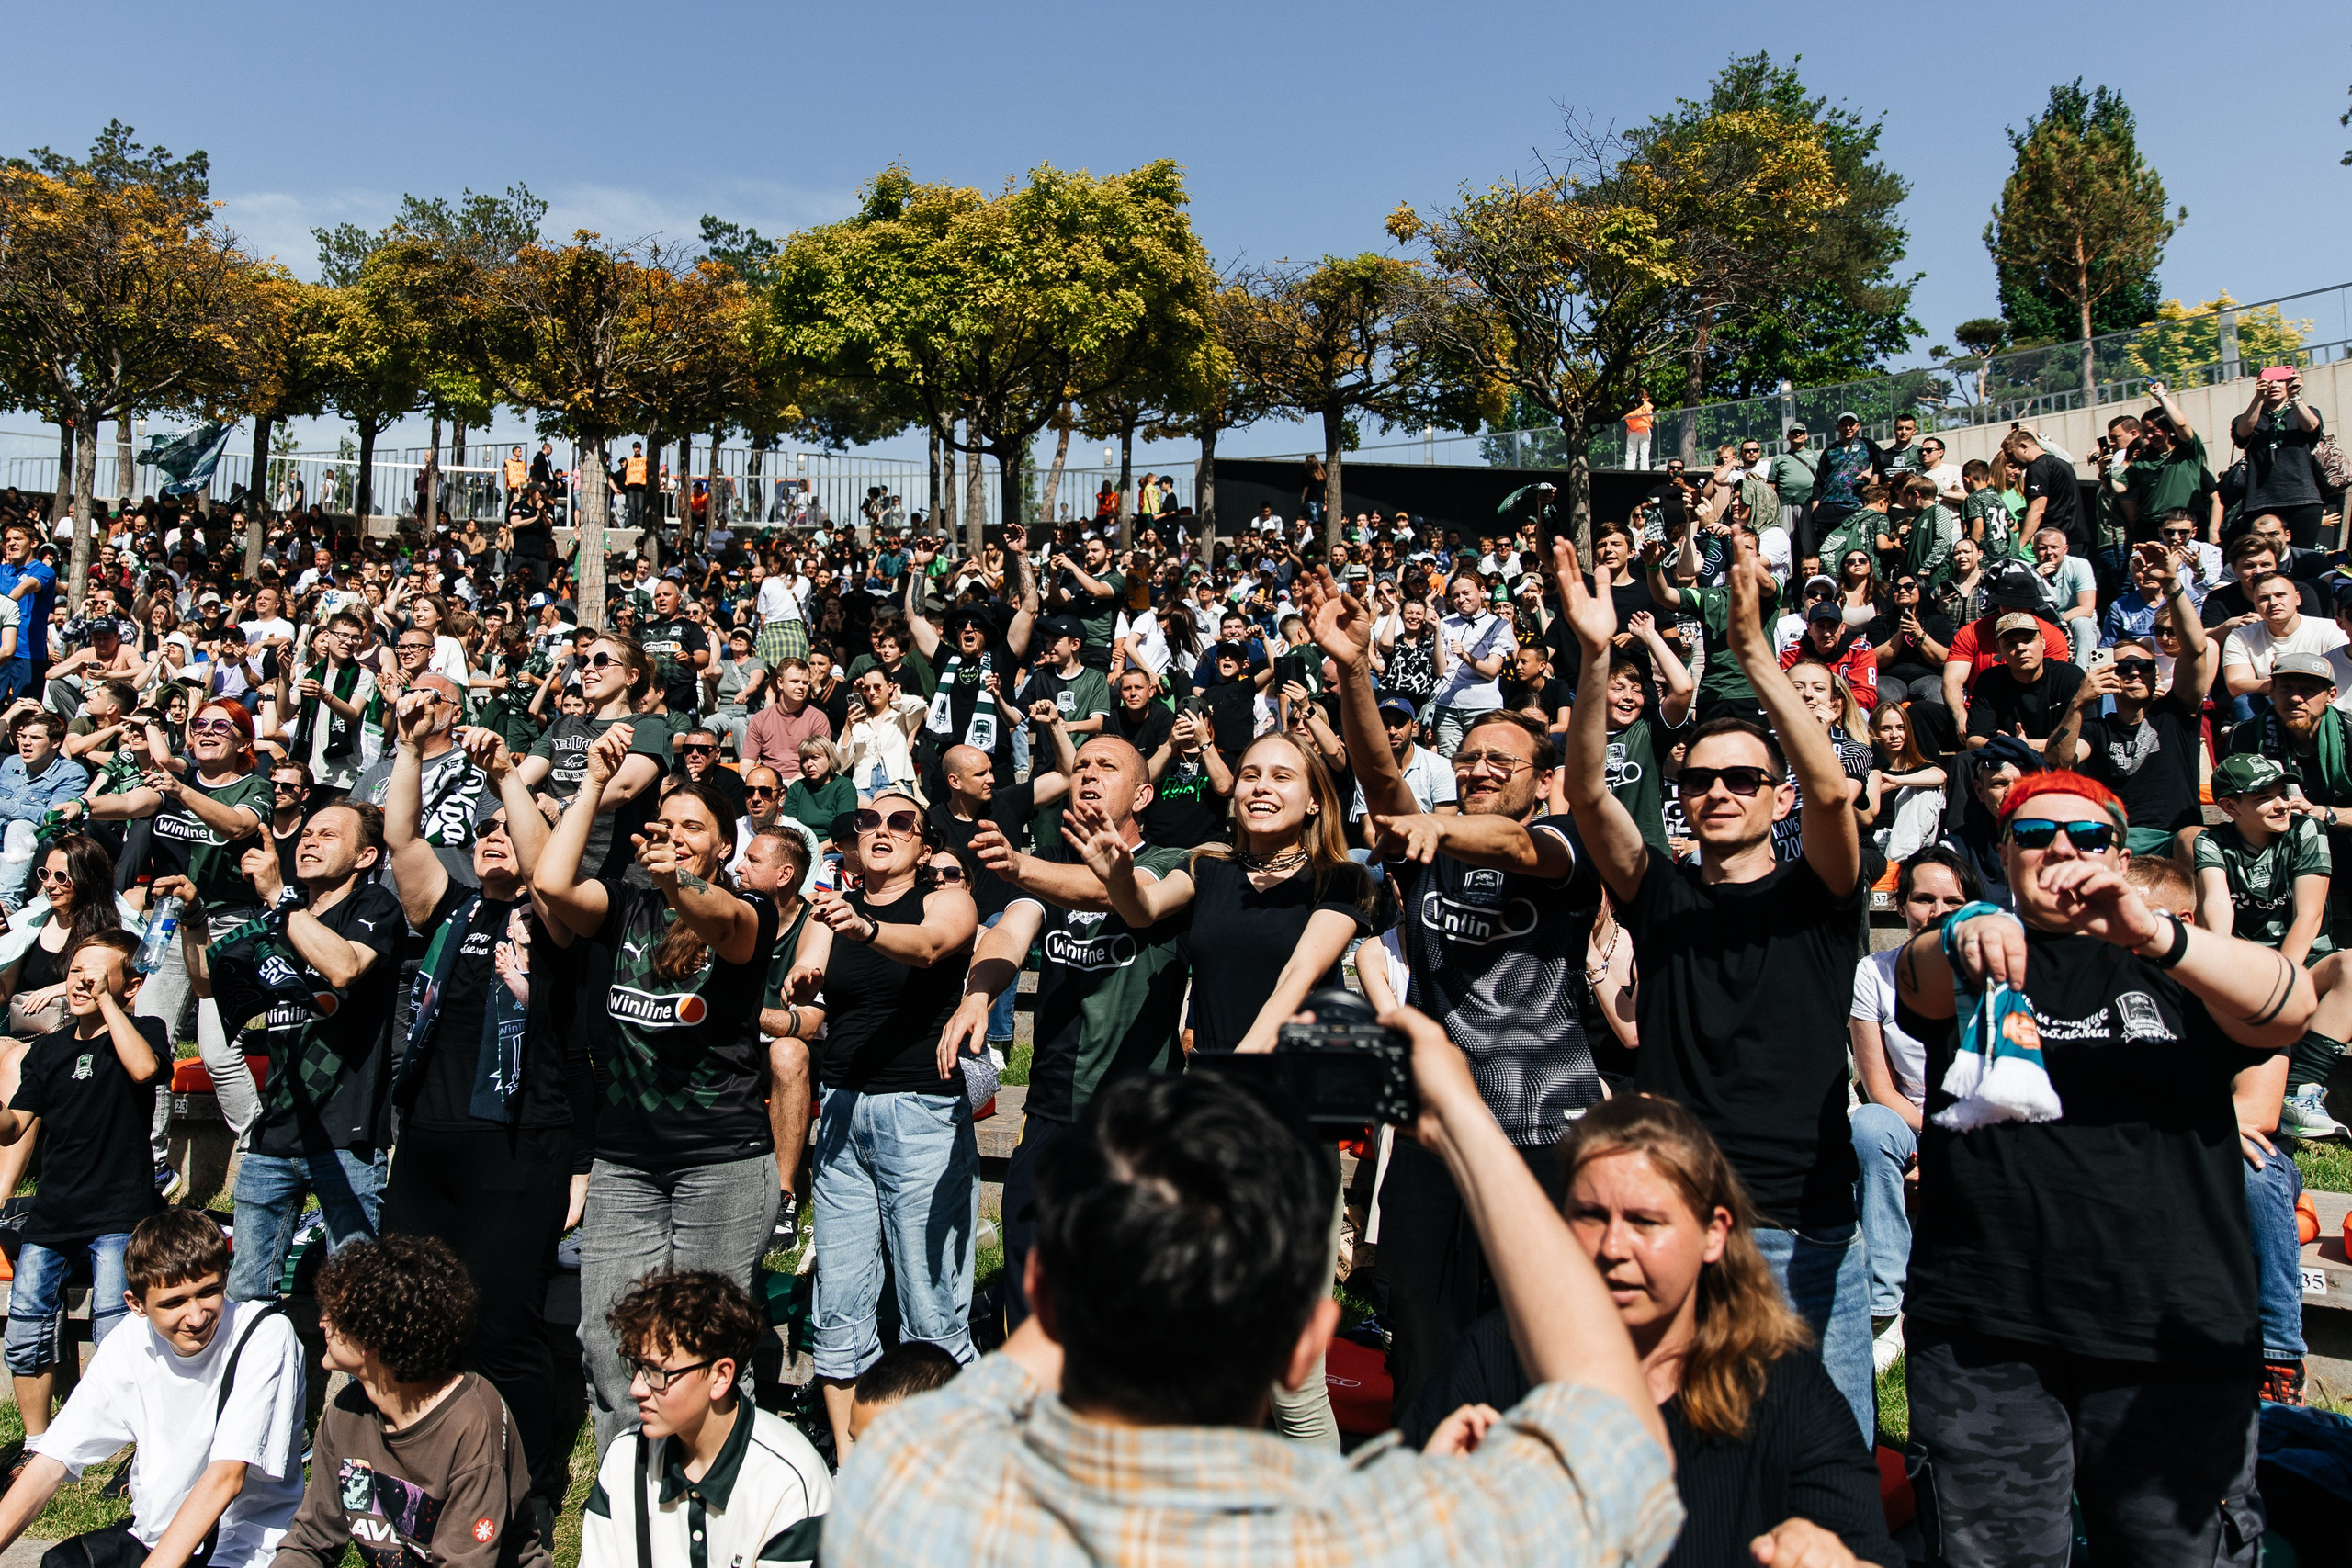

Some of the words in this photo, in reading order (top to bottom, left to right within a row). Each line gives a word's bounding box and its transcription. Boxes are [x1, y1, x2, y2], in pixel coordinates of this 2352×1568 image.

[564, 771, 588, 780] KRASNO
[158, 818, 209, 839] Winline
[1771, 816, 1800, 840] КЛУБ
[1875, 895, 1886, 904] 37
[610, 992, 673, 1020] Winline
[175, 1100, 187, 1111] 23
[2301, 1272, 2324, 1290] 35
